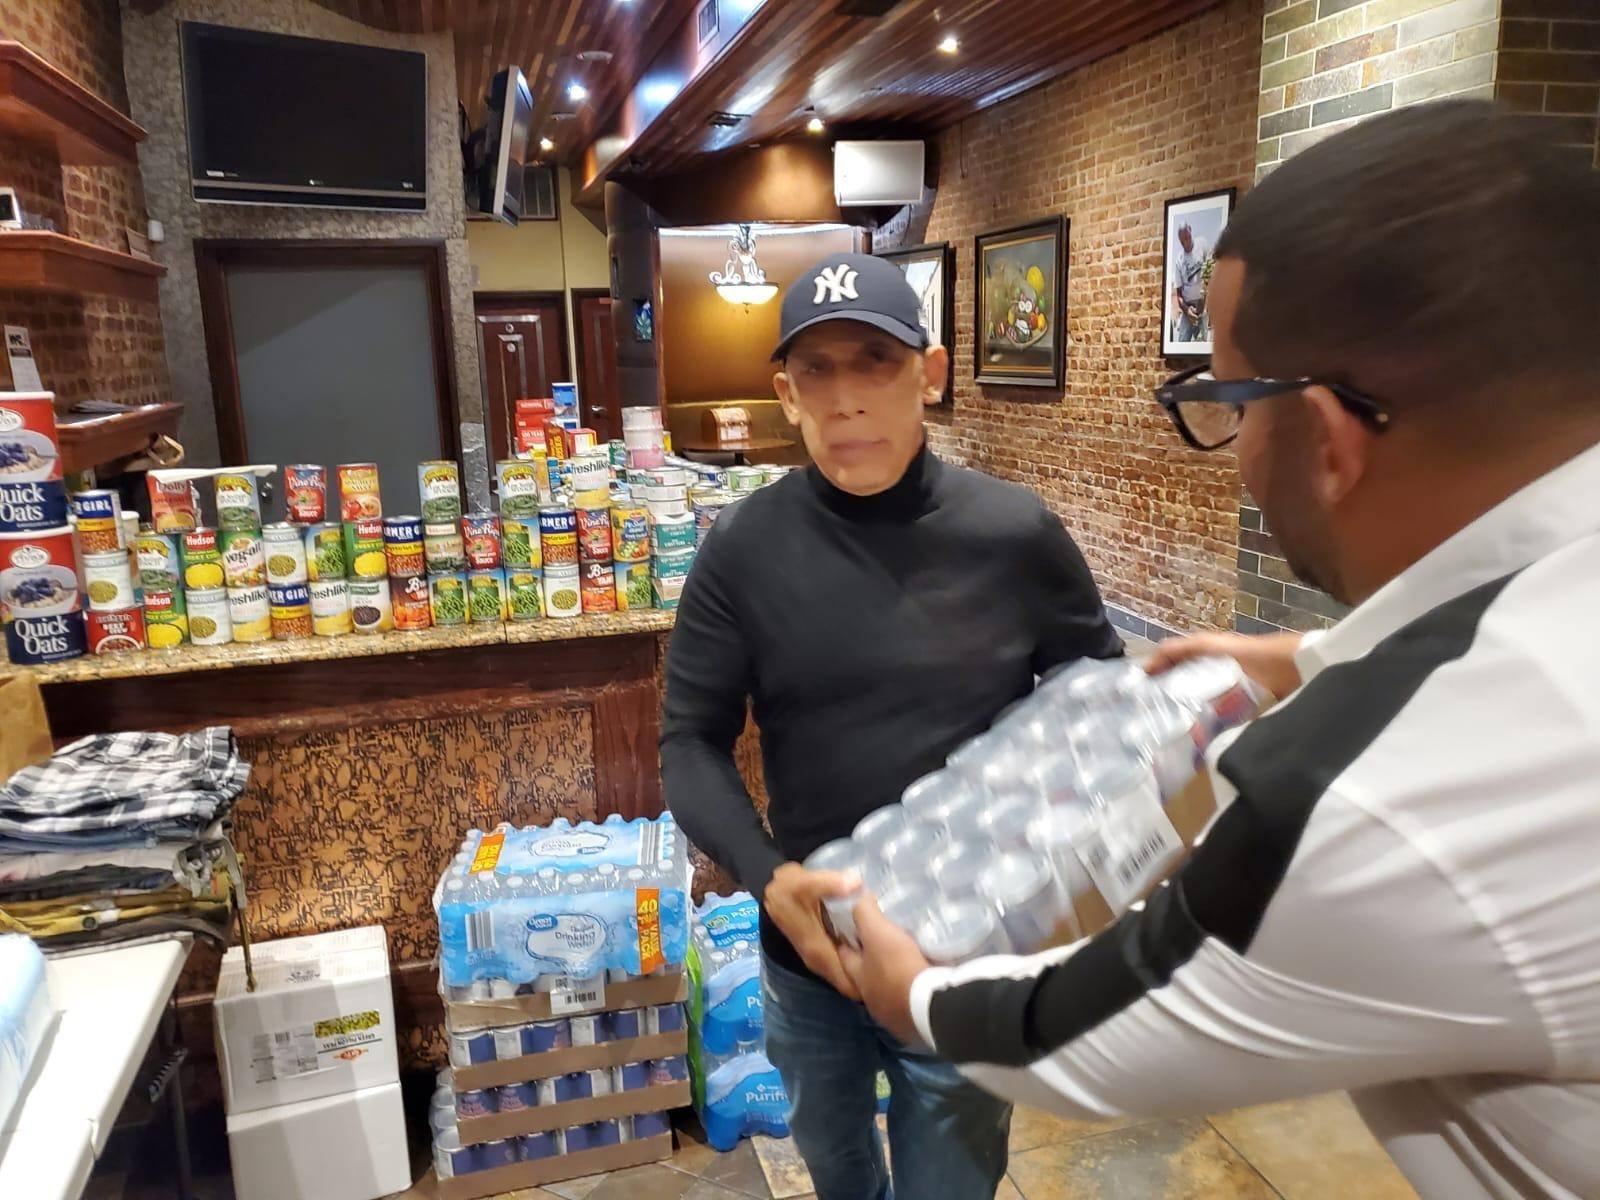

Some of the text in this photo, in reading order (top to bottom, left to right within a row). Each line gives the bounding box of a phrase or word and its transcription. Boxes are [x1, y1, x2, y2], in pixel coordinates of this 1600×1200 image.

[813, 264, 859, 304] NY
[82, 499, 112, 512] GIRL
[0, 503, 45, 523] Oats
[187, 534, 215, 546] Hudson
[285, 587, 309, 601] GIRL
[15, 615, 70, 641] Quick
[24, 636, 68, 655] Oats
[637, 899, 658, 913] 40
[555, 931, 596, 942] Drinking
